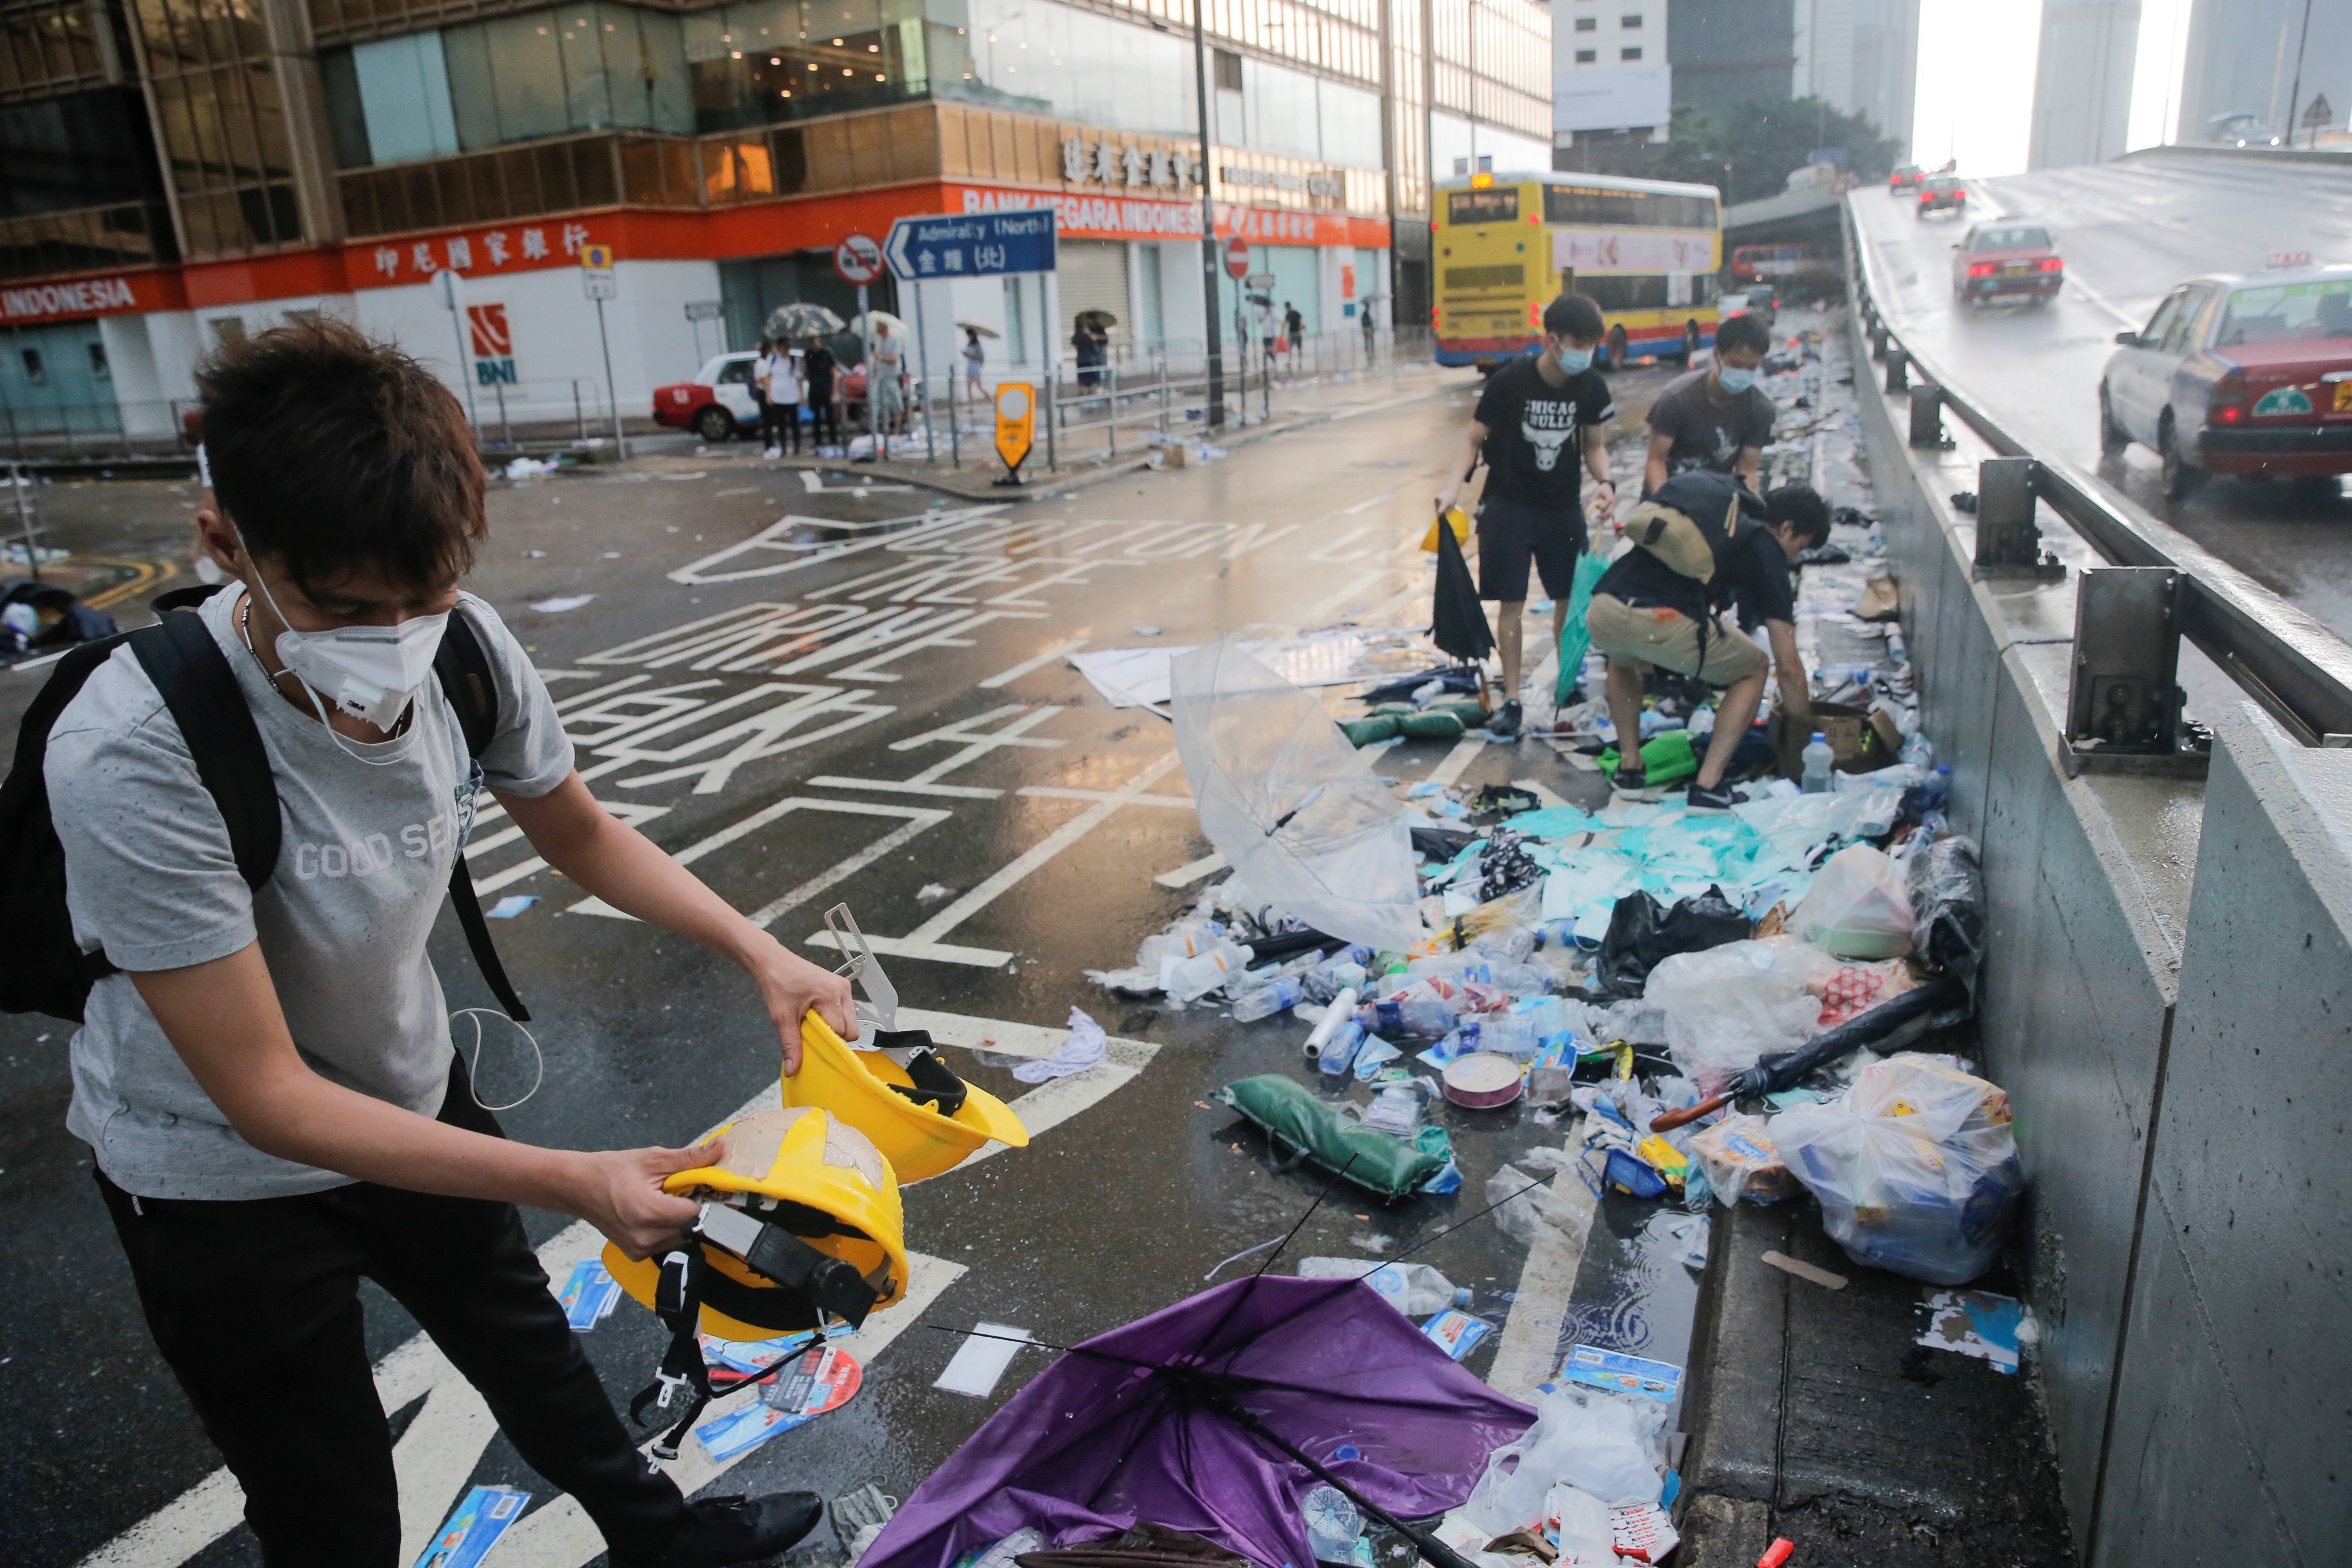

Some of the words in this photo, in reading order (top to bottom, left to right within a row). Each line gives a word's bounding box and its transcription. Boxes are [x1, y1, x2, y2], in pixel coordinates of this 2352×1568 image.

[375, 224, 589, 279] 印尼國家銀行
[2, 278, 136, 317] INDONESIA
[475, 359, 517, 386] BNI
[804, 554, 1148, 605] TREE
[574, 603, 1053, 682] DRIVE
[295, 833, 393, 880] GOOD
[1620, 1508, 1645, 1516] kinder
[1626, 1517, 1650, 1525] kinder
